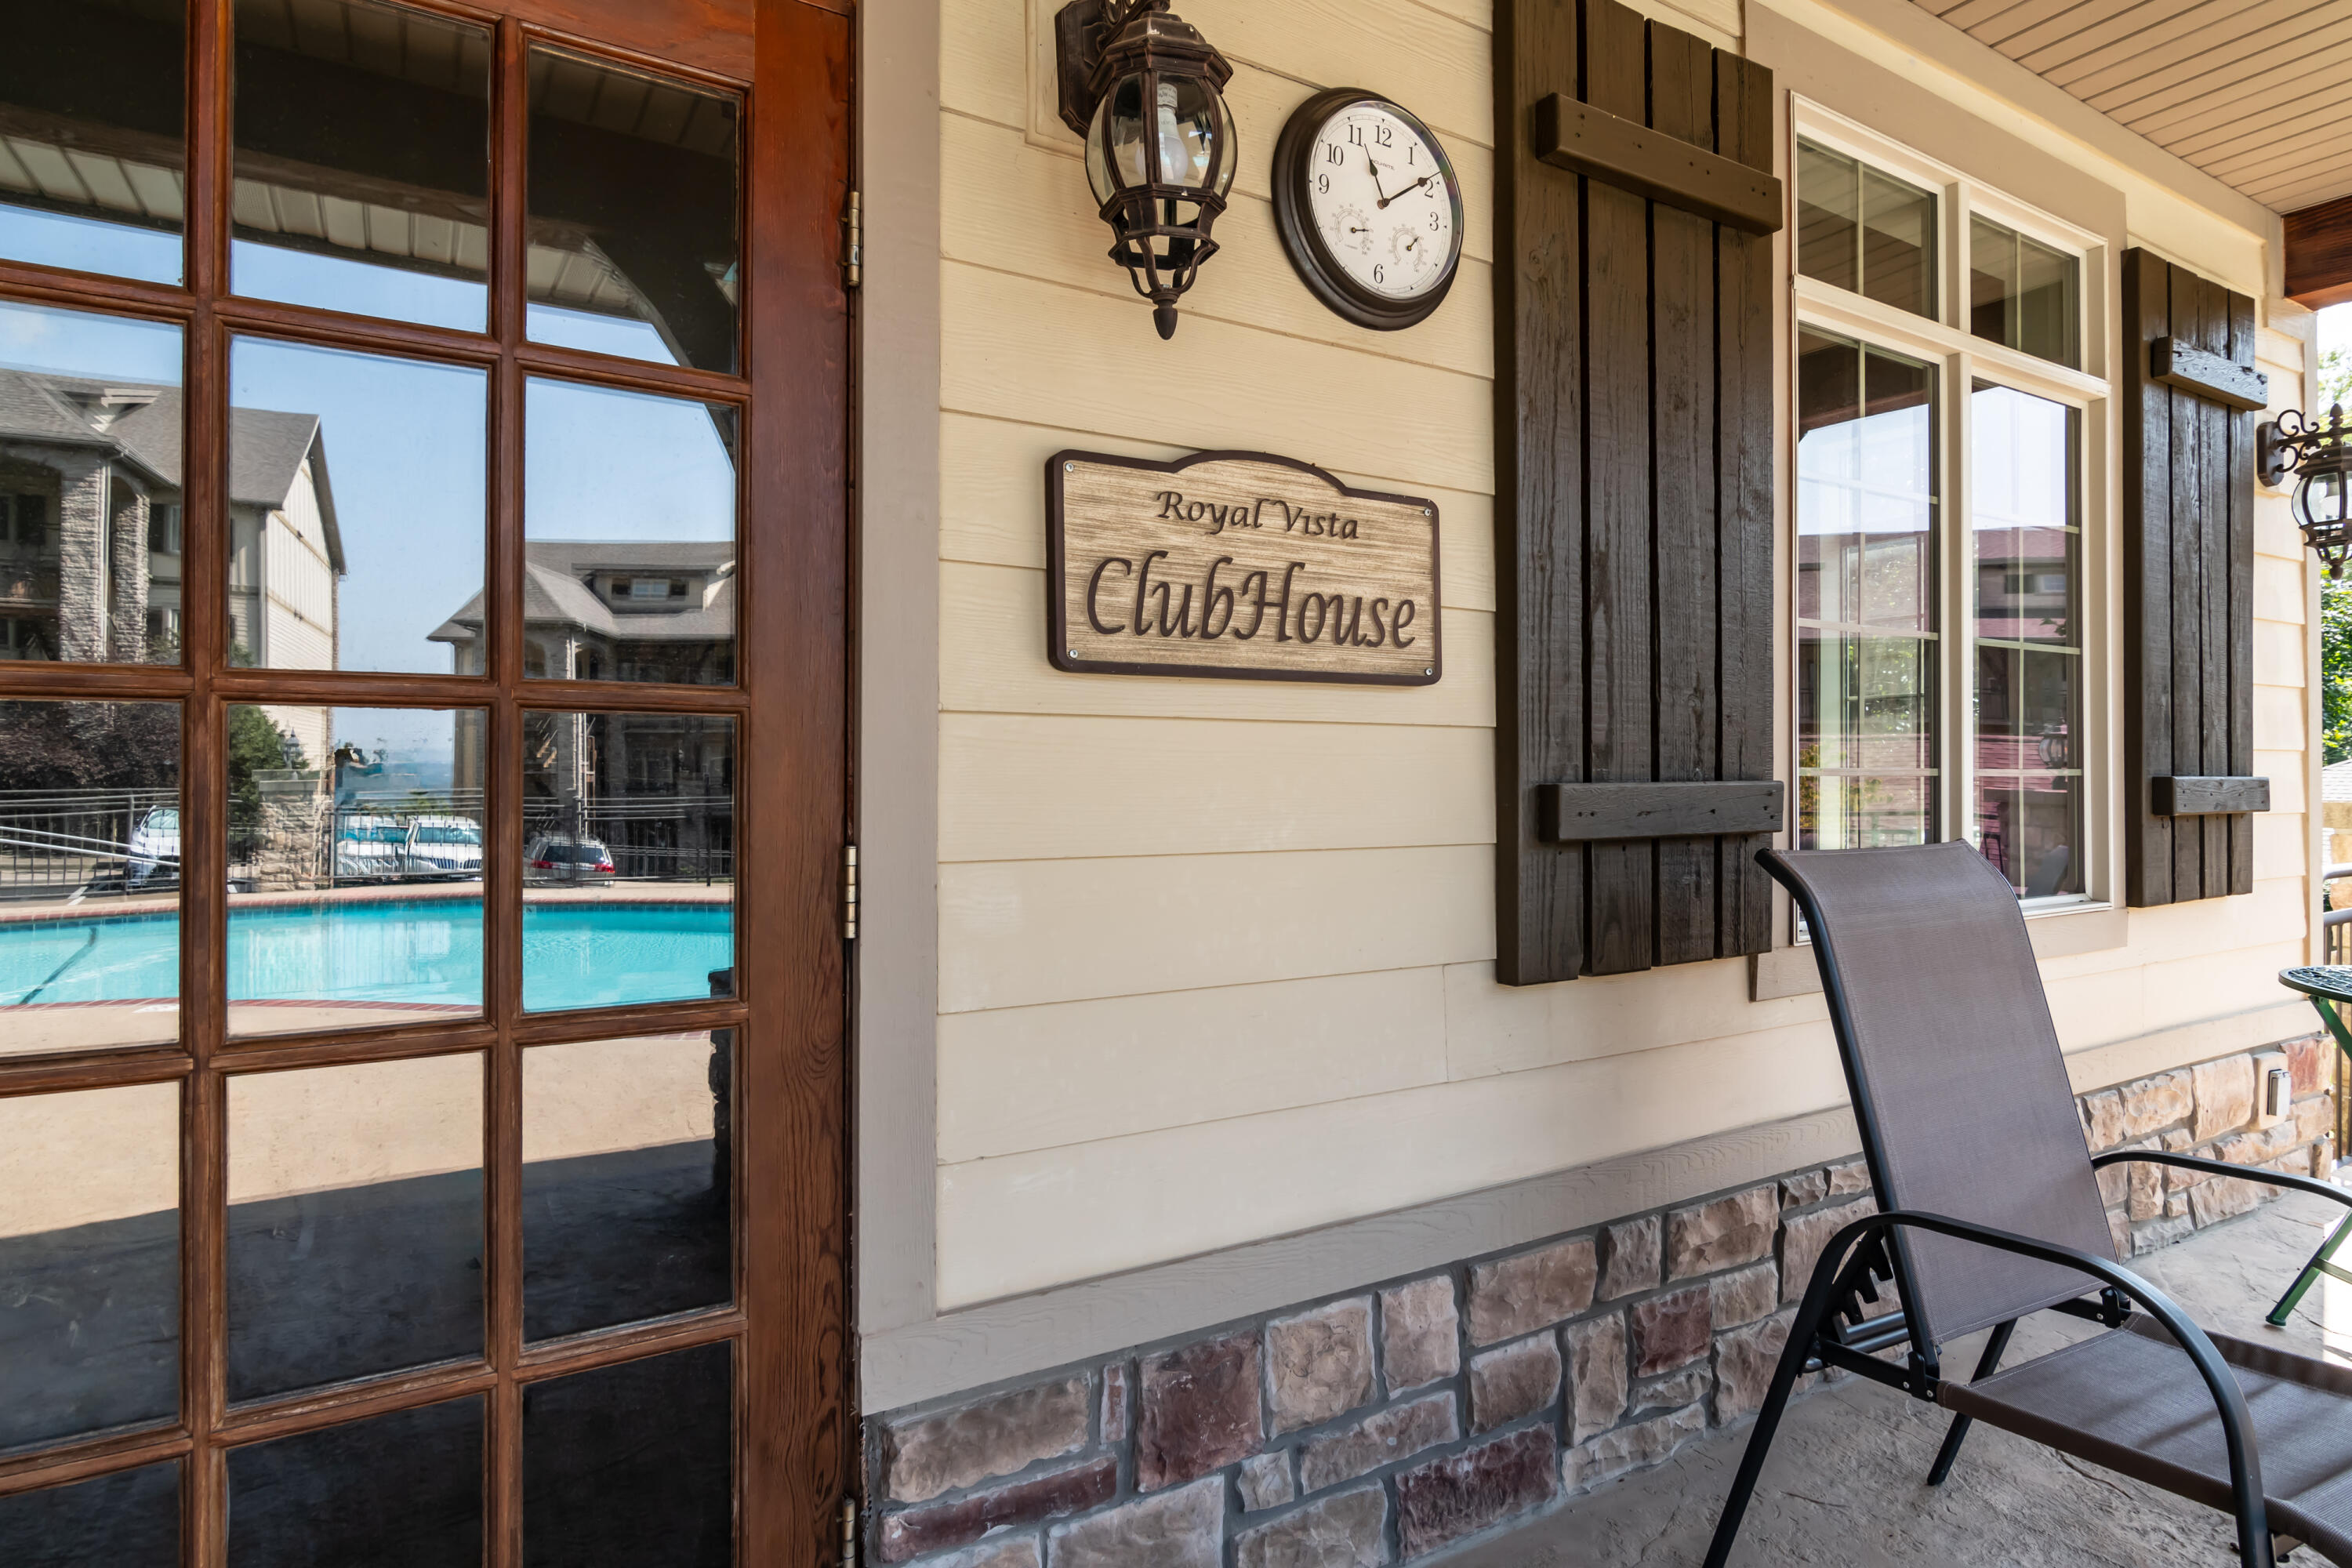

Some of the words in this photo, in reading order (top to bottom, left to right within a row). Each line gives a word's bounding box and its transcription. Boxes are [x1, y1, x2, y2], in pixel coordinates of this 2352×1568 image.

[1348, 124, 1364, 147] 11
[1374, 125, 1392, 148] 12
[1327, 143, 1344, 166] 10
[1407, 146, 1415, 166] 1
[1318, 173, 1330, 194] 9
[1424, 178, 1434, 198] 2
[1429, 212, 1439, 231] 3
[1374, 263, 1384, 284] 6
[1156, 491, 1271, 535] Royal
[1272, 499, 1359, 539] Vista
[1087, 550, 1415, 648] ClubHouse
